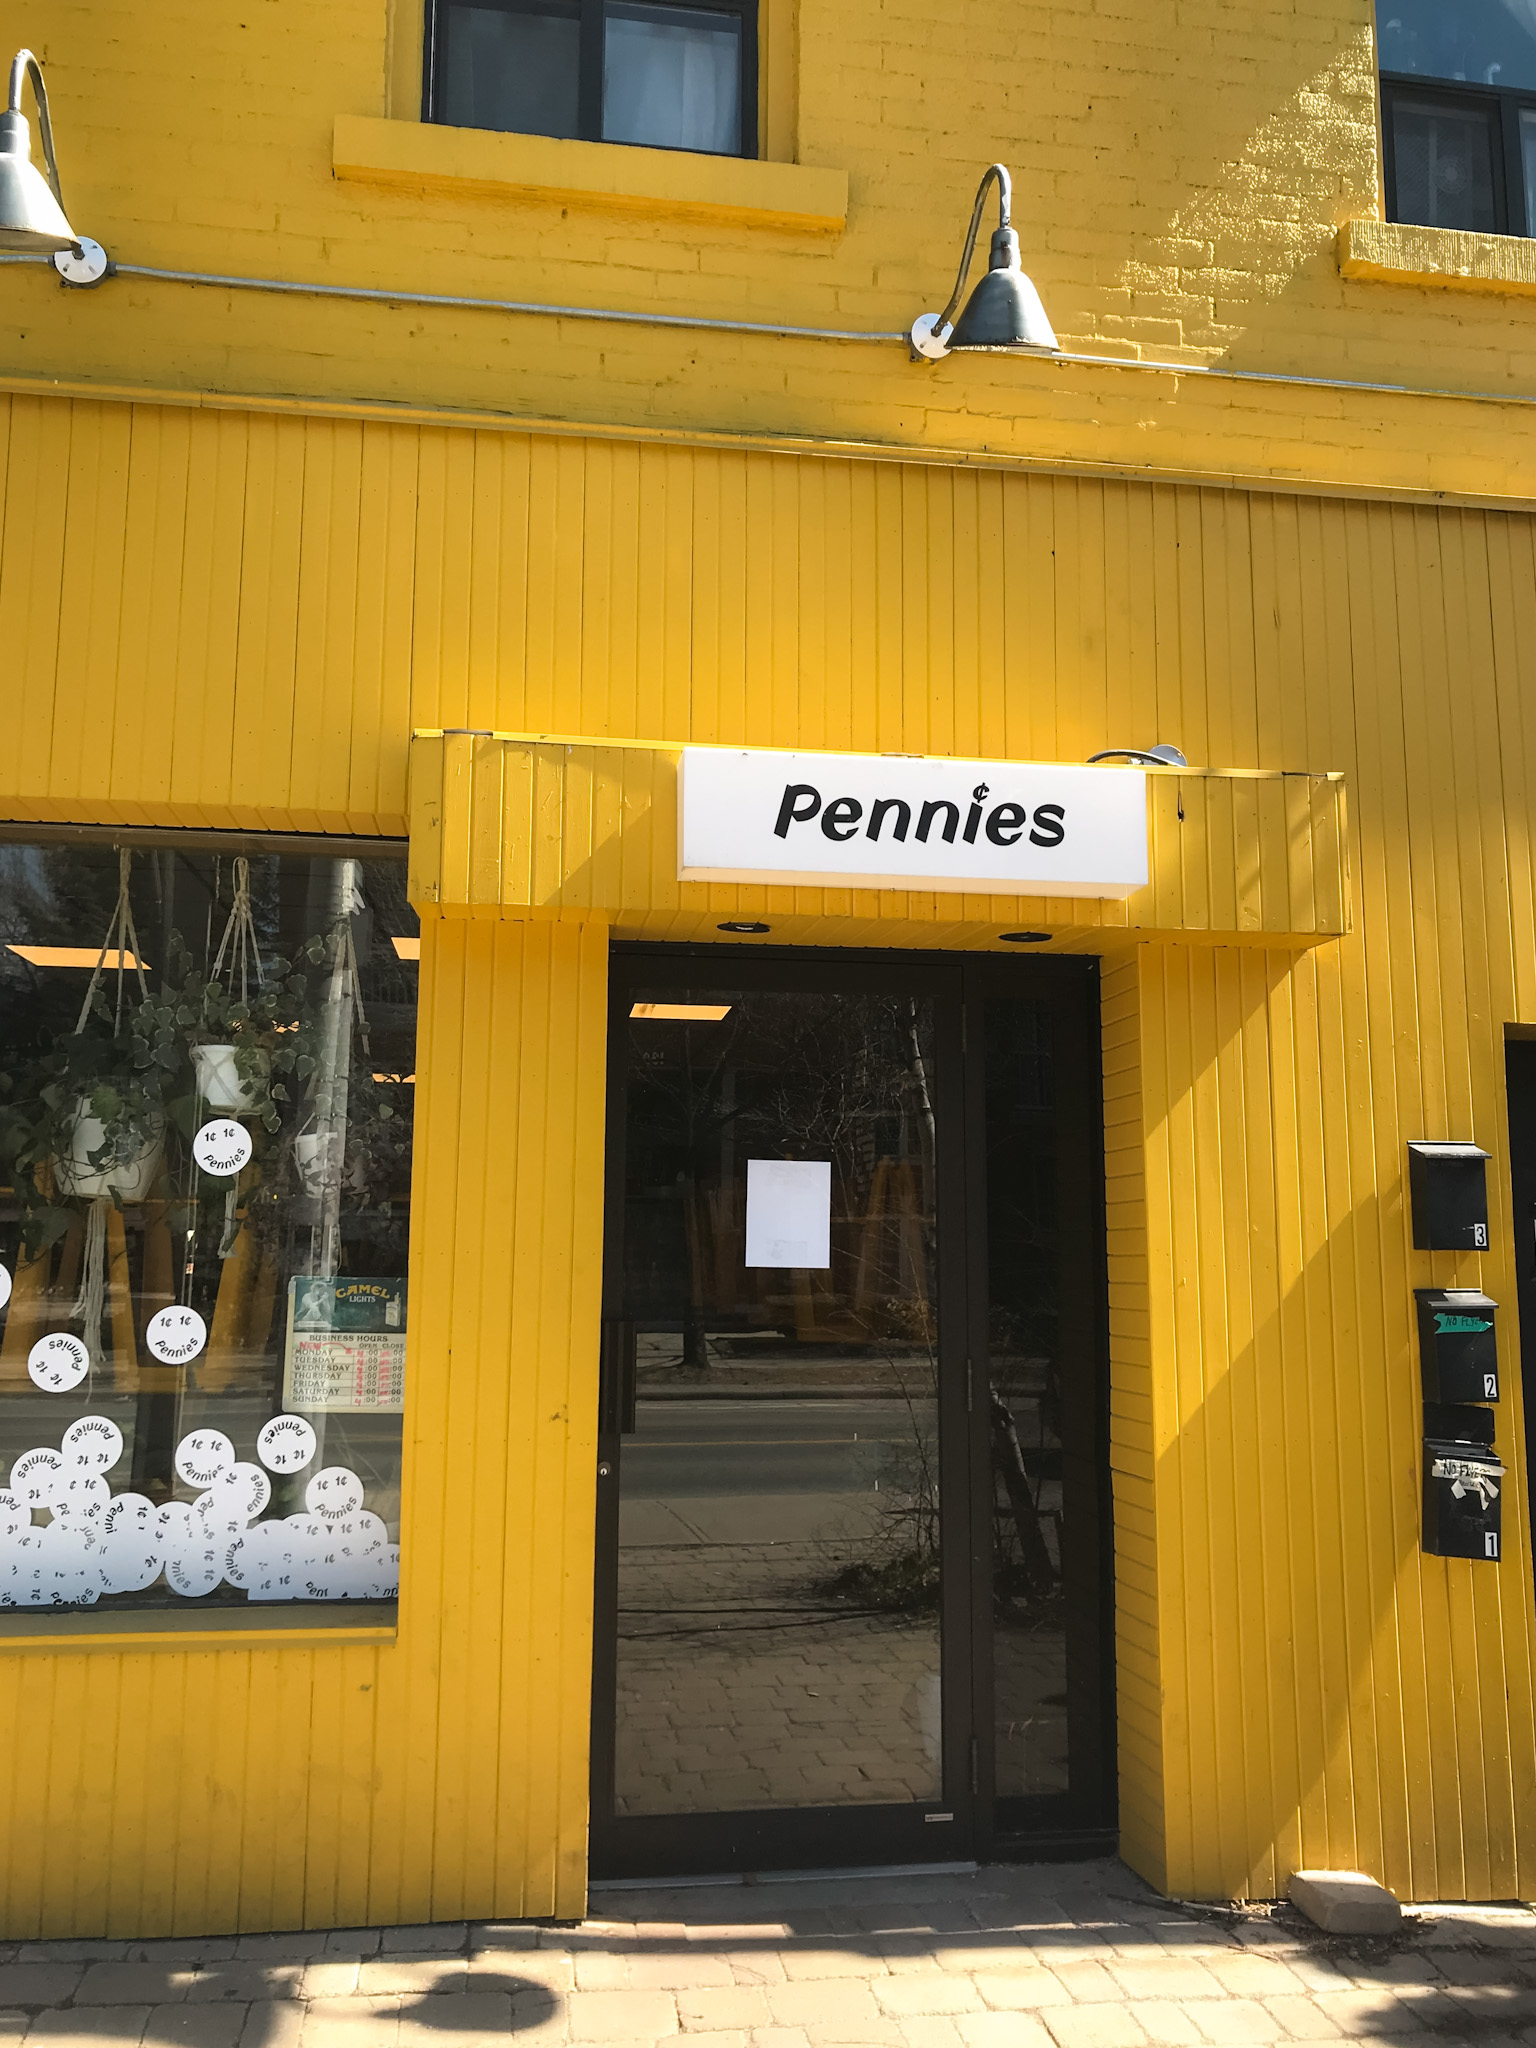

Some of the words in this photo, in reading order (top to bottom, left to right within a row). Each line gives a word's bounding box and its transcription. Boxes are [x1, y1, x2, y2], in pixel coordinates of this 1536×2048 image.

[774, 783, 1065, 847] Pennies
[205, 1132, 216, 1141] 1¢
[223, 1128, 235, 1137] 1¢
[203, 1148, 245, 1169] Pennies
[1477, 1226, 1485, 1245] 3
[335, 1284, 390, 1299] CAMEL
[349, 1295, 376, 1303] LIGHTS
[160, 1317, 172, 1327] 1¢
[180, 1315, 192, 1326] 1¢
[49, 1339, 83, 1371] Pennies
[155, 1338, 198, 1358] Pennies
[1486, 1376, 1495, 1396] 2
[70, 1422, 114, 1443] Pennies
[264, 1421, 306, 1444] Pennies
[191, 1438, 203, 1450] 1¢
[210, 1440, 222, 1451] 1¢
[17, 1454, 62, 1478] Pennies
[1443, 1462, 1457, 1476] NO
[84, 1479, 97, 1489] 1¢
[247, 1474, 264, 1512] ennies
[317, 1480, 329, 1490] 1¢
[335, 1476, 348, 1486] 1¢
[314, 1496, 357, 1519] Pennies
[104, 1502, 124, 1534] Penni
[1488, 1535, 1495, 1555] 1
